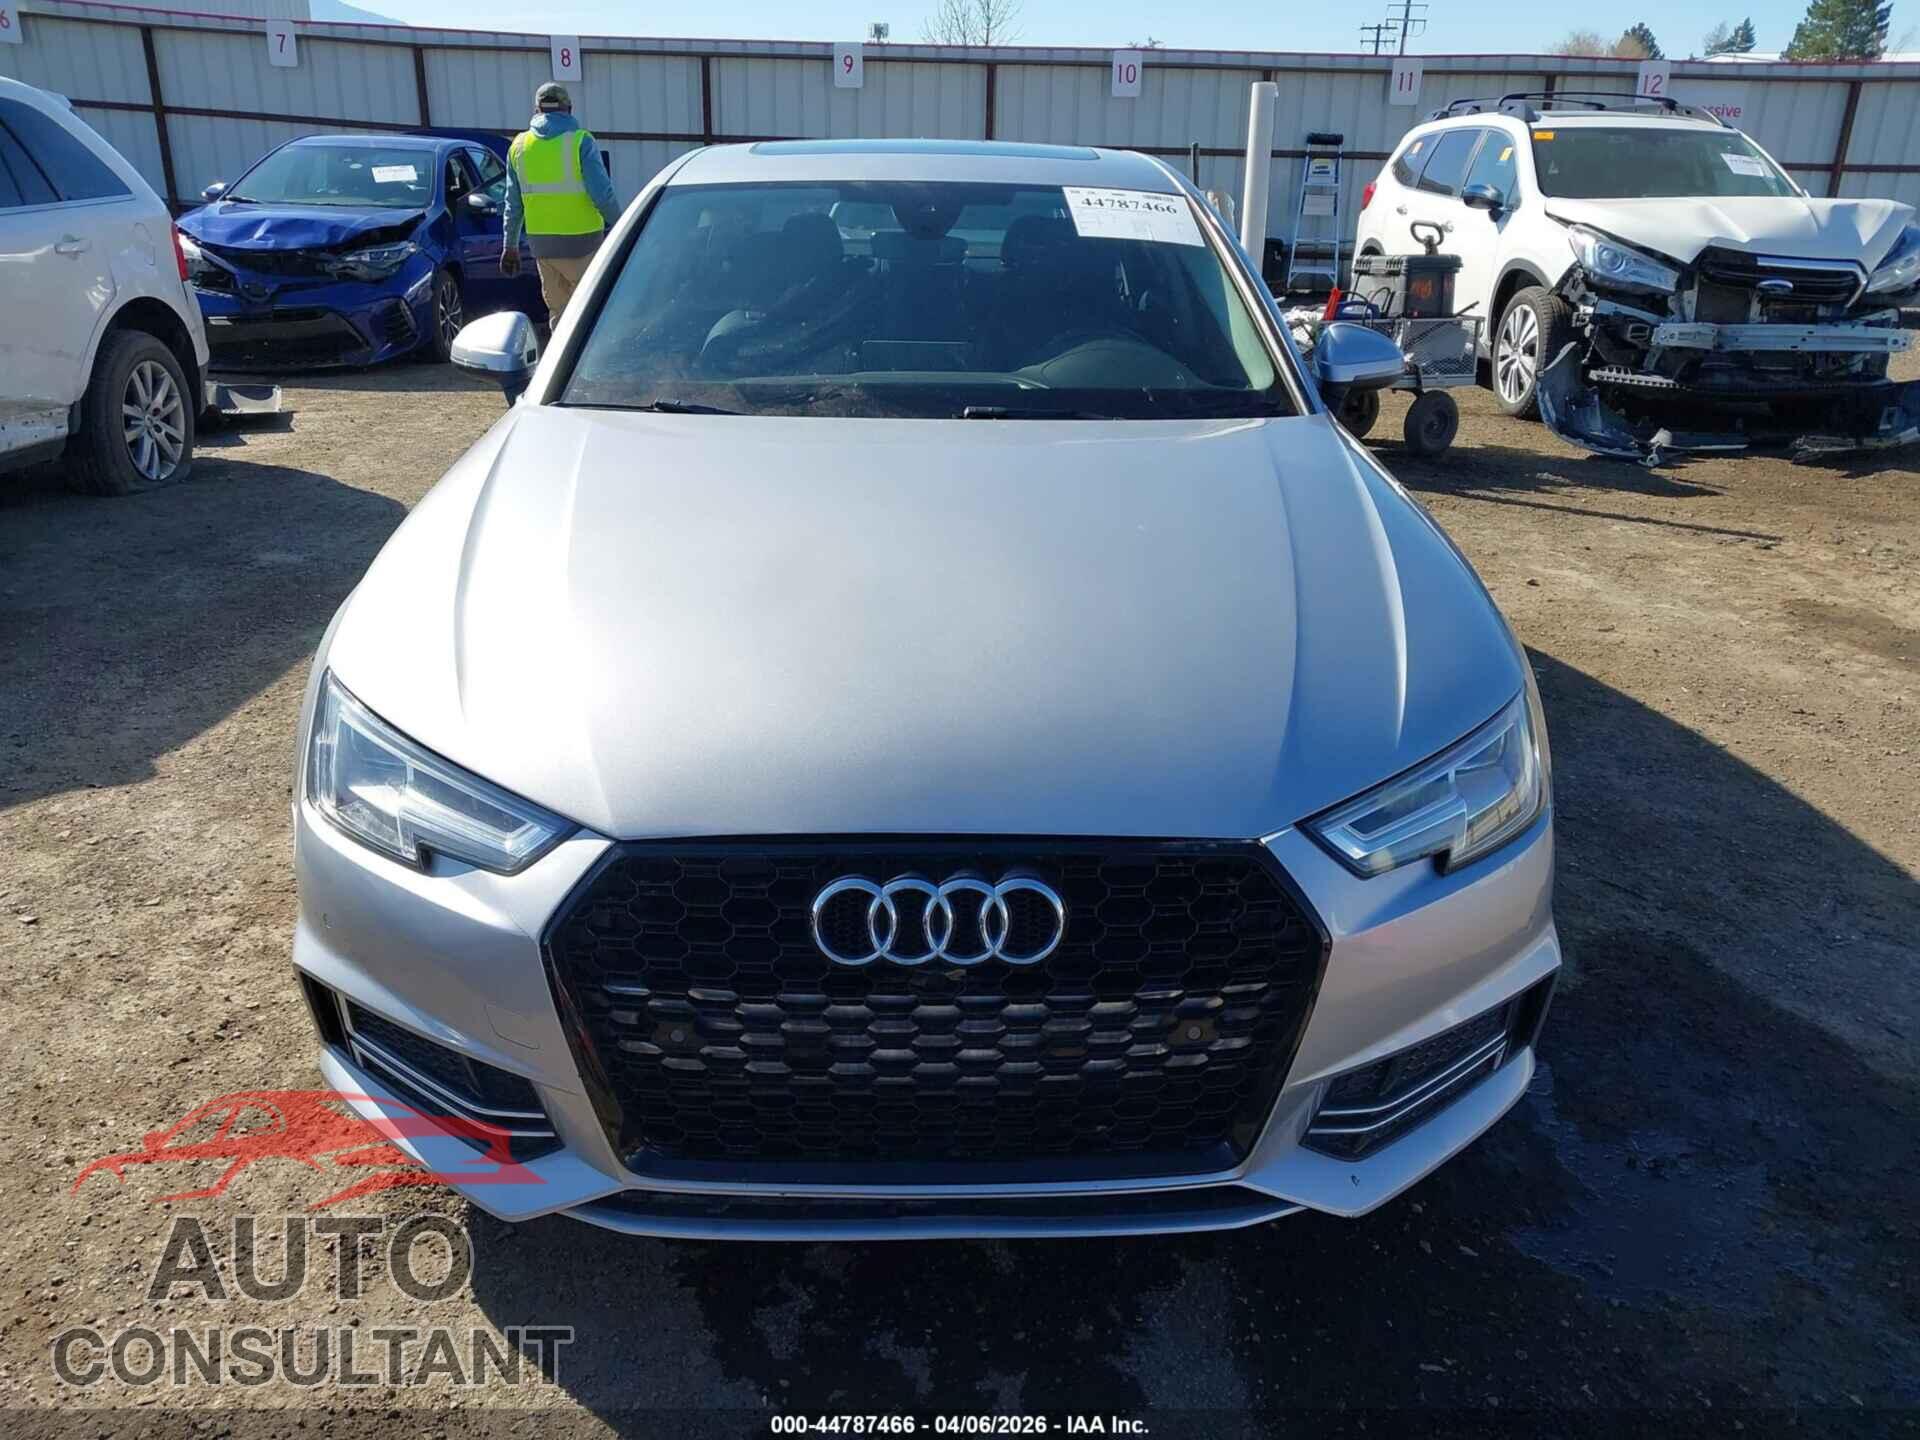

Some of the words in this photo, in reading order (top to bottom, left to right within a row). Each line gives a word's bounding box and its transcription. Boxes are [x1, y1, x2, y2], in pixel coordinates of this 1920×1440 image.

[0, 9, 10, 29] 6
[275, 33, 286, 53] 7
[560, 47, 571, 67] 8
[843, 55, 854, 74] 9
[1118, 63, 1137, 84] 10
[1399, 71, 1413, 92] 11
[1643, 74, 1664, 95] 12
[1081, 197, 1177, 214] 44787466
